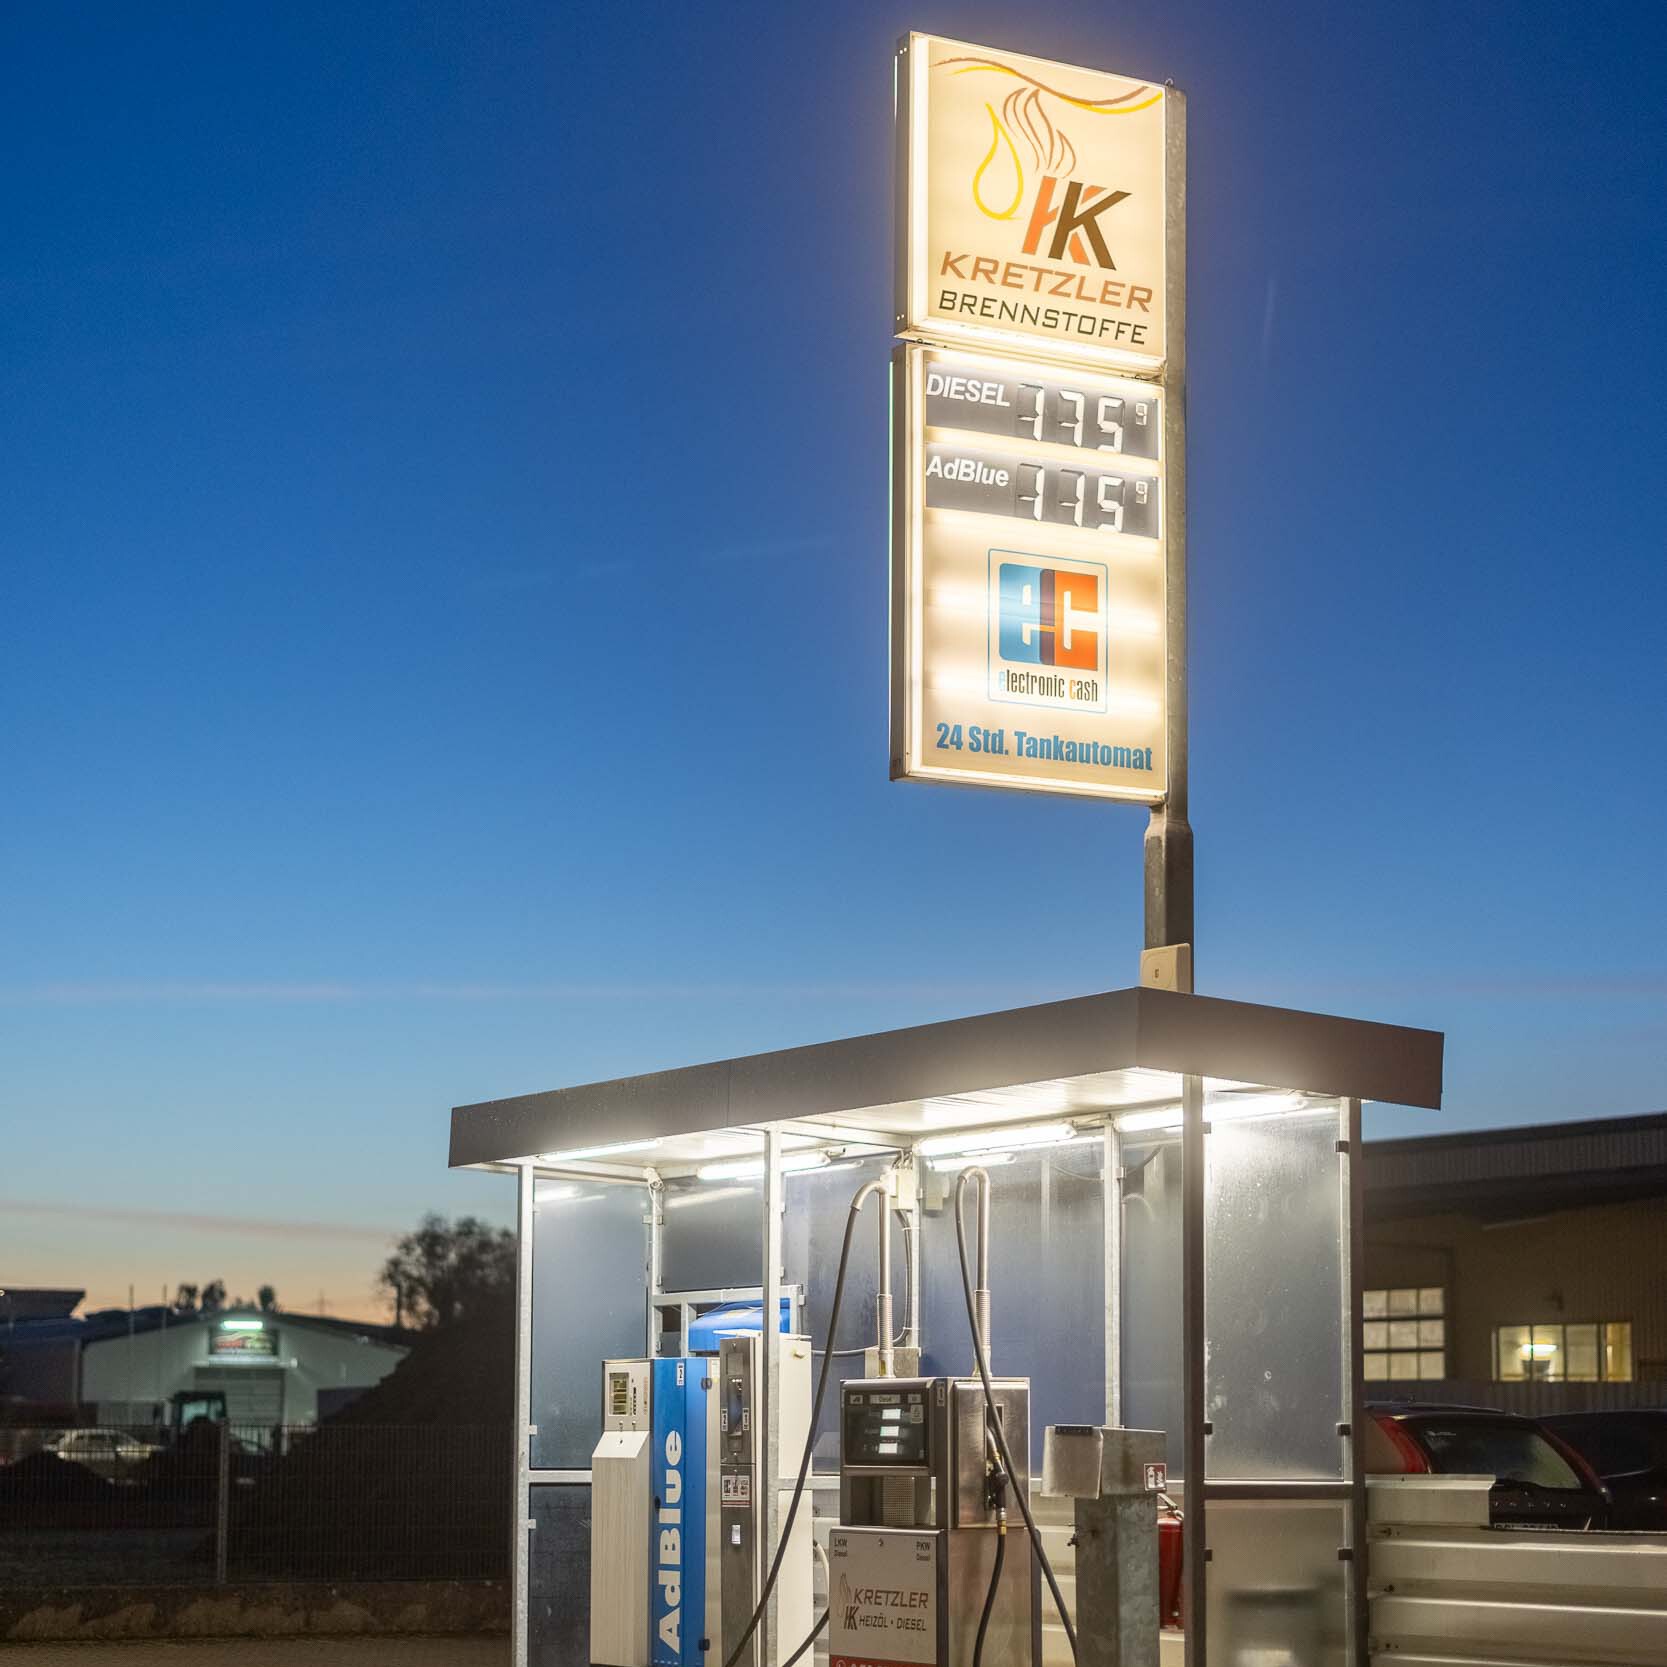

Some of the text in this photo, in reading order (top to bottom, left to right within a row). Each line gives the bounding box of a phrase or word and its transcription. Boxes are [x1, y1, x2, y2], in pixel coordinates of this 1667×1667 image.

[940, 251, 1153, 313] KRETZLER
[938, 289, 1149, 345] BRENNSTOFFE
[926, 373, 1011, 407] DIESEL
[926, 455, 1009, 487] AdBlue
[998, 668, 1098, 702] electronic cash
[936, 722, 1153, 771] 24 Std. Tankautomat
[658, 1430, 682, 1655] AdBlue
[853, 1588, 929, 1609] KRETZLER
[859, 1612, 927, 1632] HEIZÖL DIESEL
